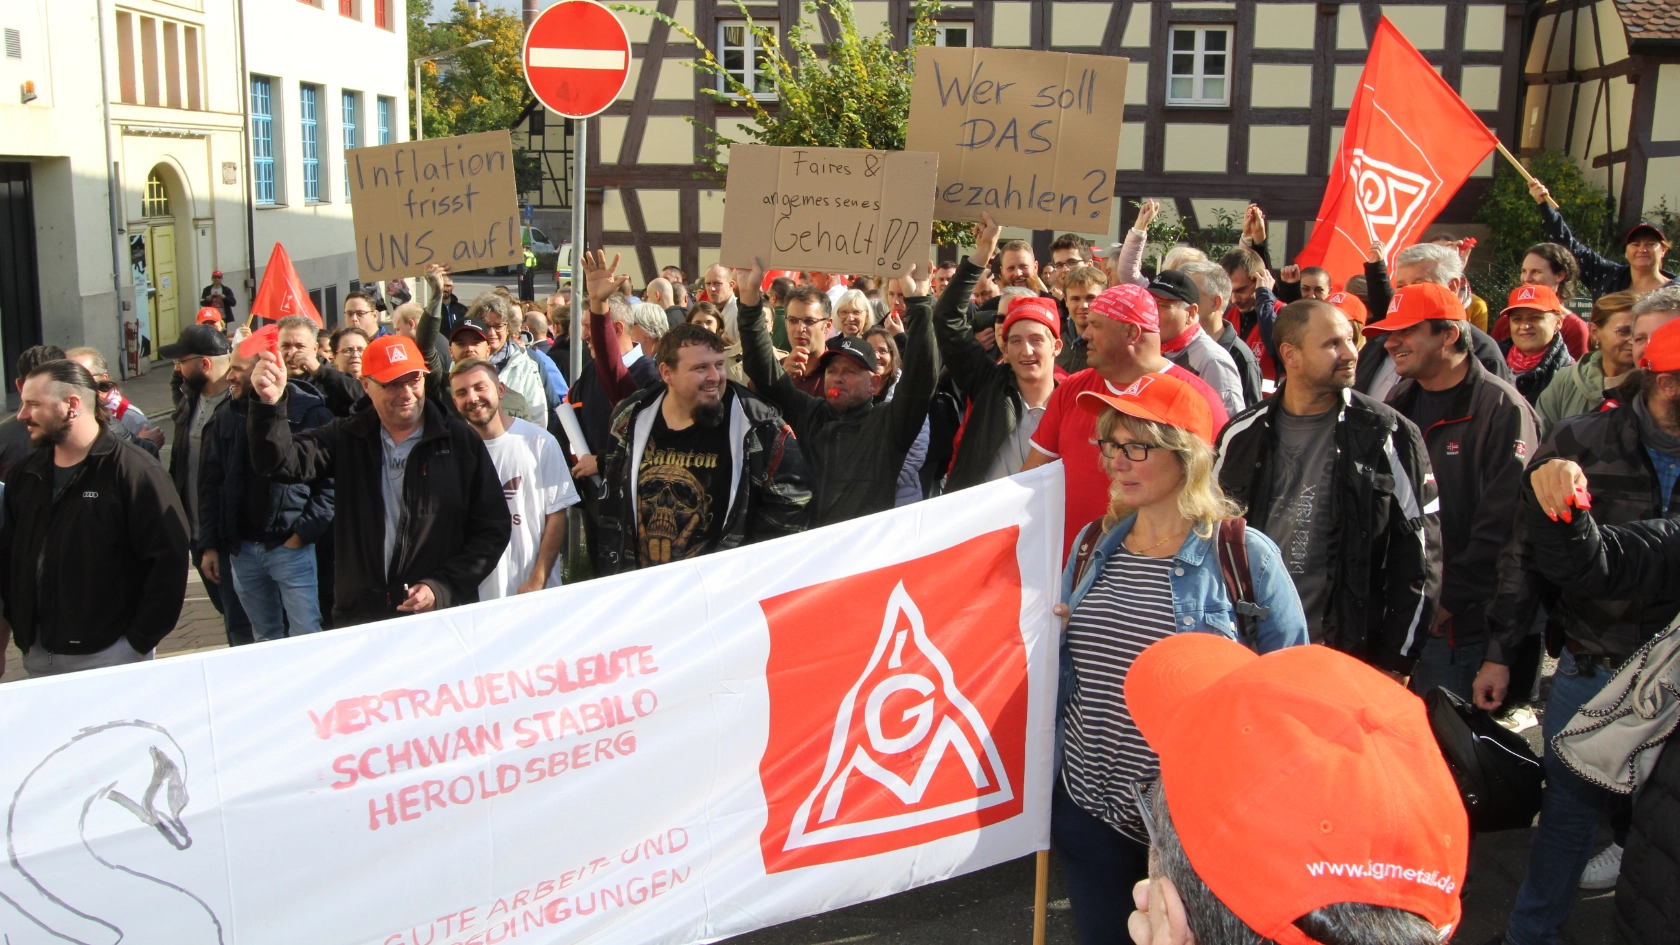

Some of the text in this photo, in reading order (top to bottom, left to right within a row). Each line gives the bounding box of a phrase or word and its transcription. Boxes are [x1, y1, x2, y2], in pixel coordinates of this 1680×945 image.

[933, 58, 1098, 115] Wer soll
[955, 117, 1054, 154] DAS
[355, 143, 506, 191] Inflation
[792, 150, 882, 178] Faires &
[404, 182, 481, 220] frisst
[762, 191, 881, 217] angemessenes
[364, 216, 515, 273] UNS auf!
[640, 436, 719, 470] Sabaton
[307, 645, 660, 740] VERTRAUENSLEUTE
[330, 688, 659, 790] SCHWAN STABILO
[368, 730, 637, 830] HEROLDSBERG
[620, 827, 689, 864] UND
[450, 866, 691, 945] EDINGUNGEN
